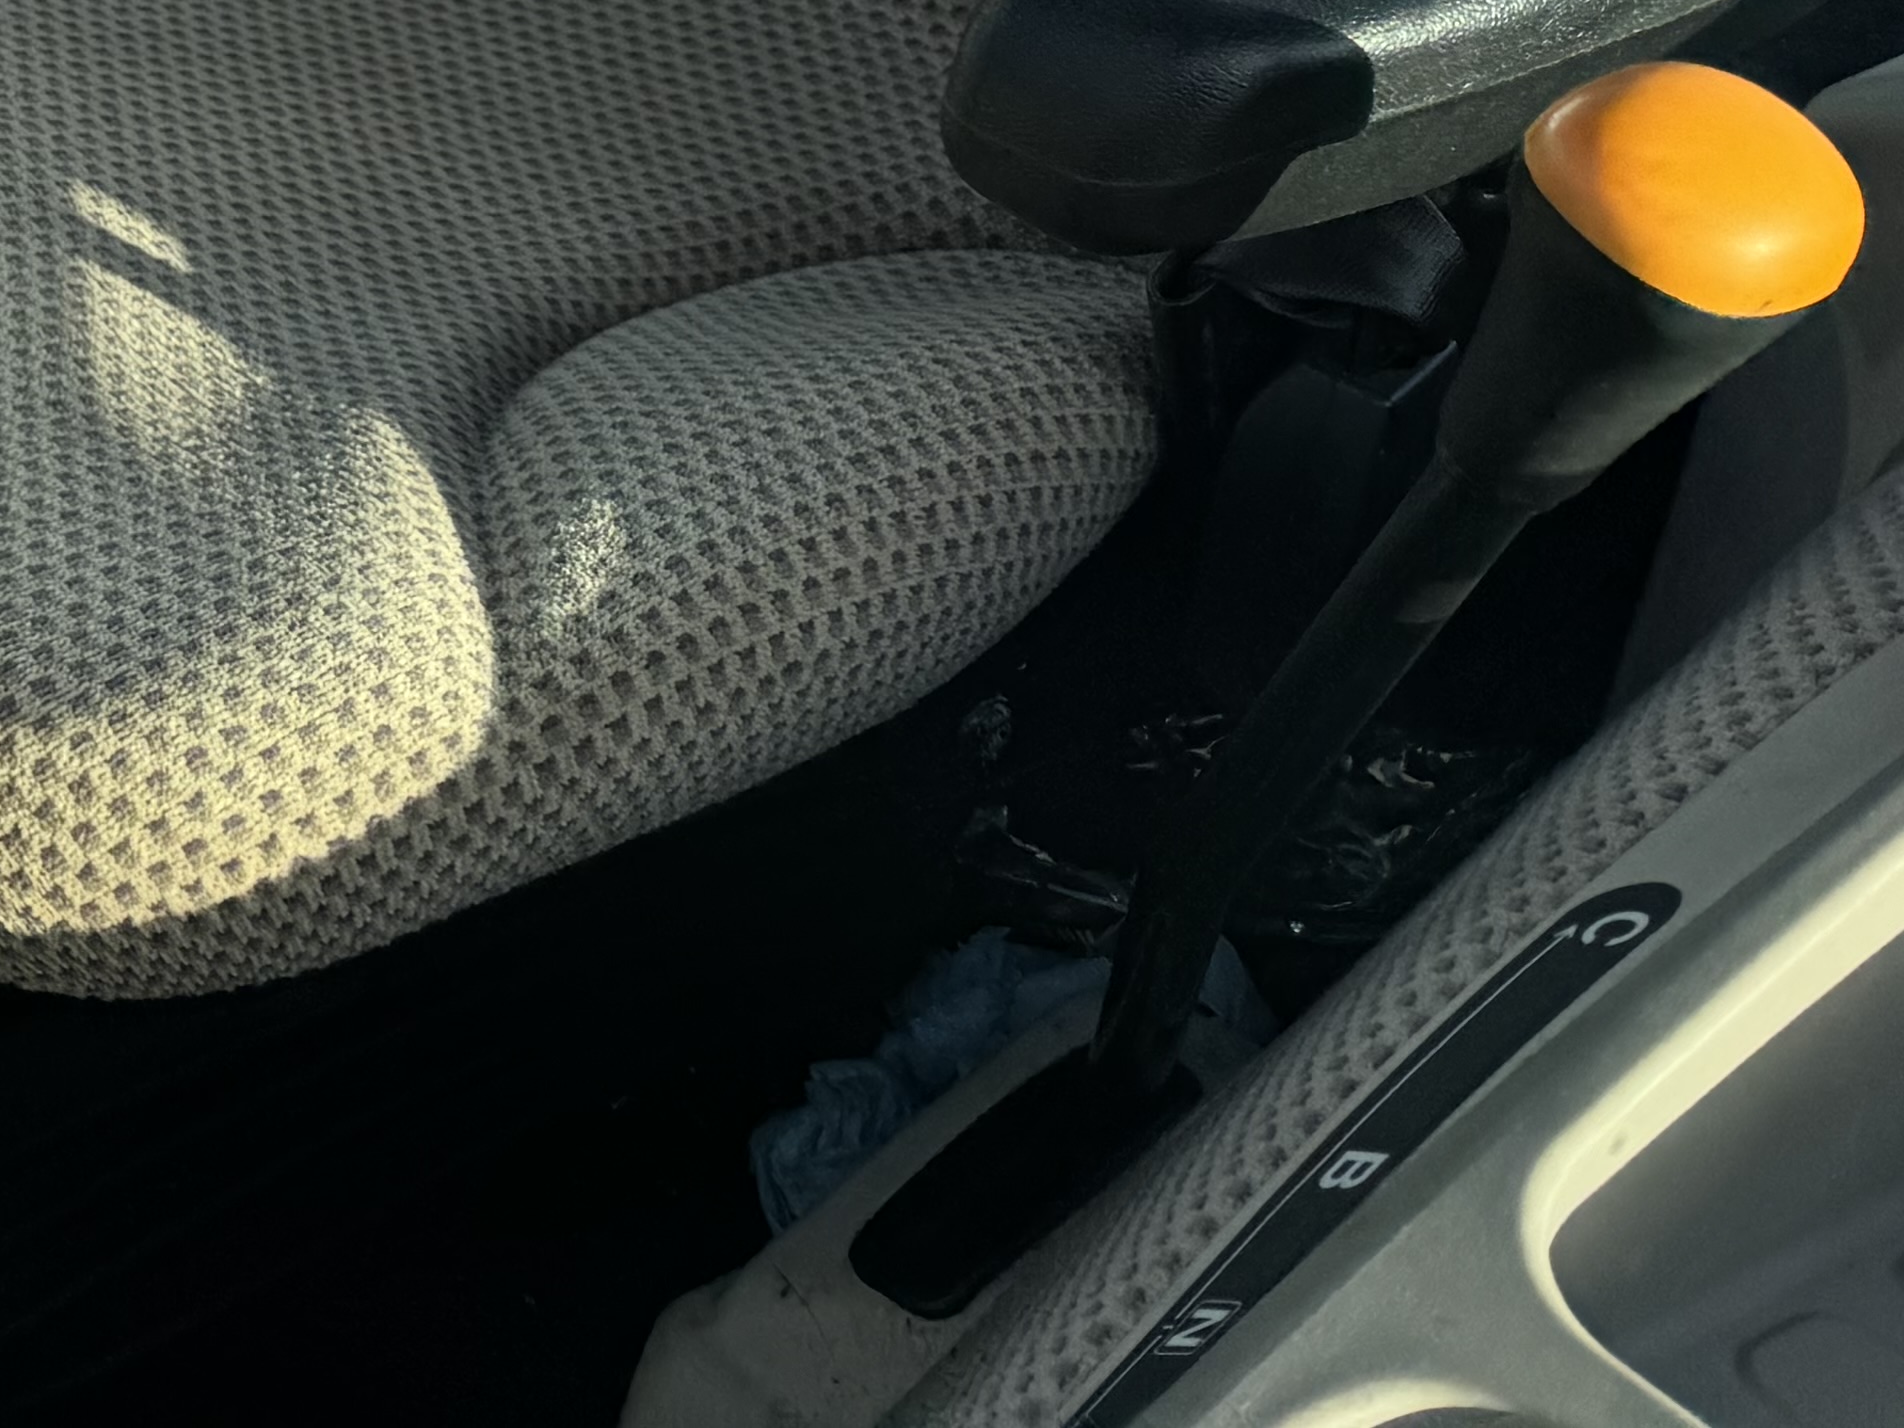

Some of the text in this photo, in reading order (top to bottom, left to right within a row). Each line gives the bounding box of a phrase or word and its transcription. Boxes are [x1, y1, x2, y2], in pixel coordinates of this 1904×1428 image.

[1581, 910, 1650, 947] C
[1318, 1149, 1390, 1190] B
[1165, 1308, 1233, 1347] N
